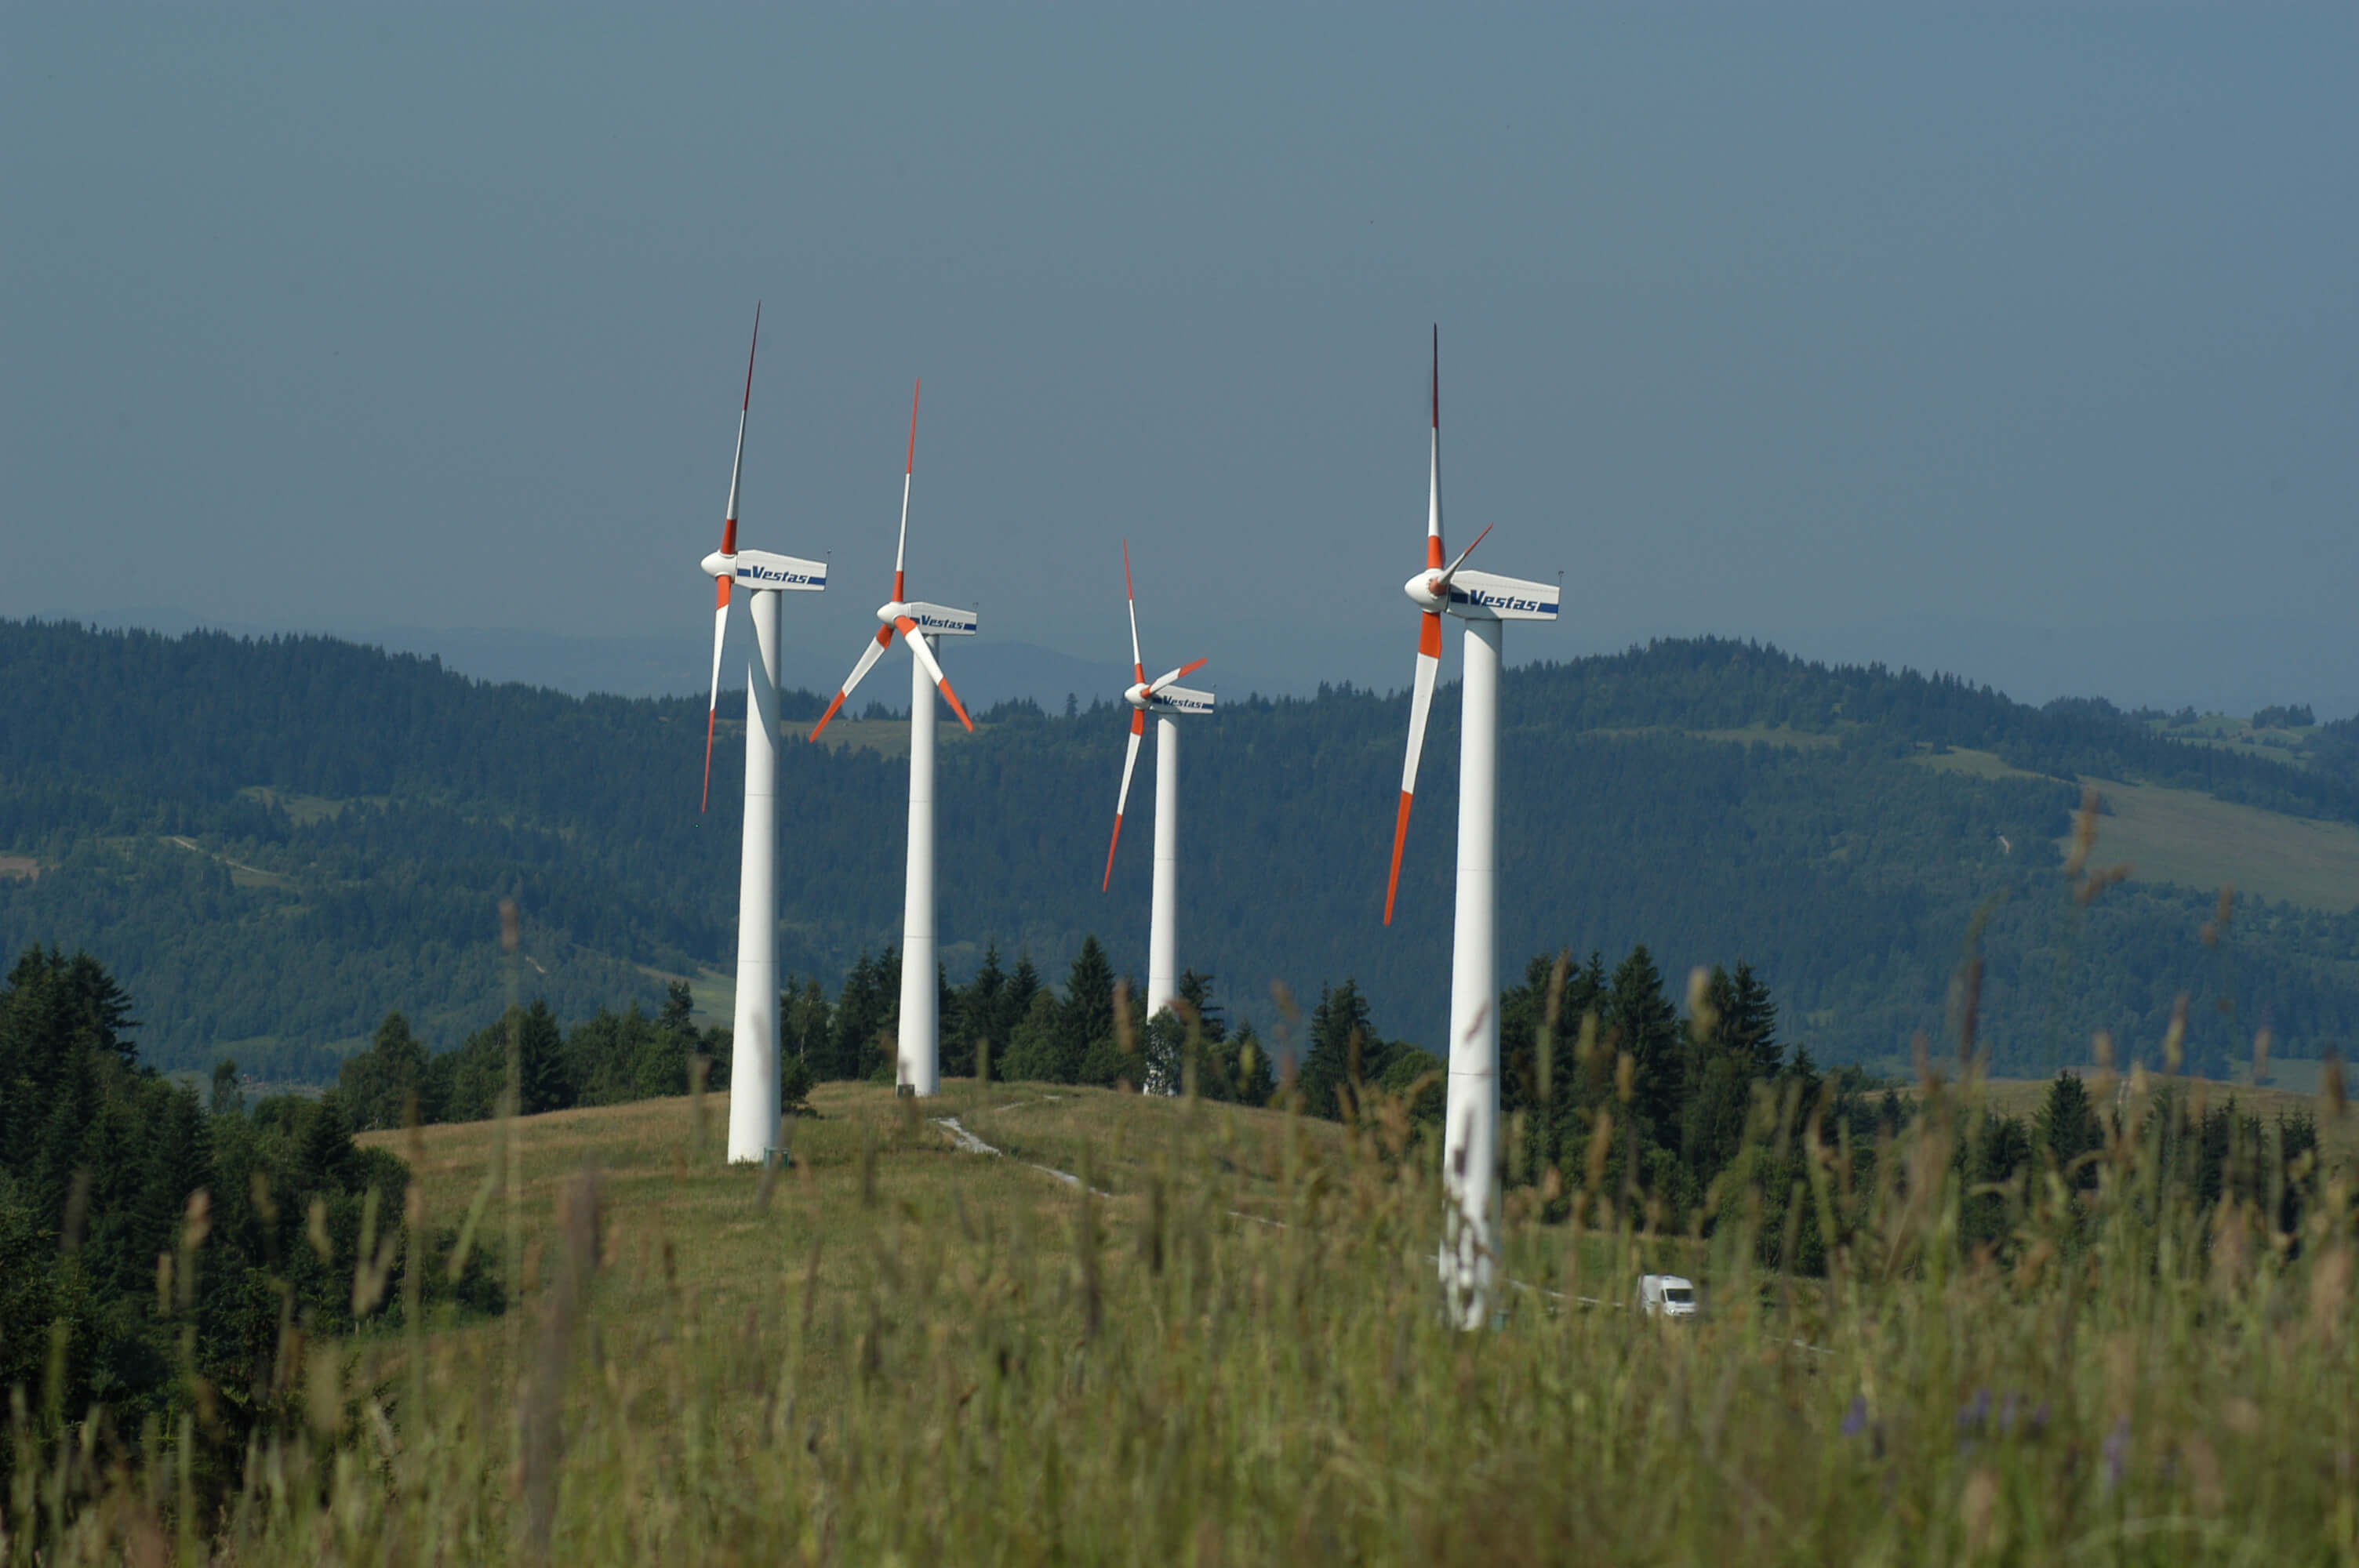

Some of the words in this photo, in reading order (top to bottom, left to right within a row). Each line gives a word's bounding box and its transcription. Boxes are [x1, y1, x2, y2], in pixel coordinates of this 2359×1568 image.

[752, 565, 808, 583] Vestas
[1470, 589, 1537, 612] Vestas
[921, 615, 963, 630] Vestas
[1163, 695, 1201, 709] Vestas
